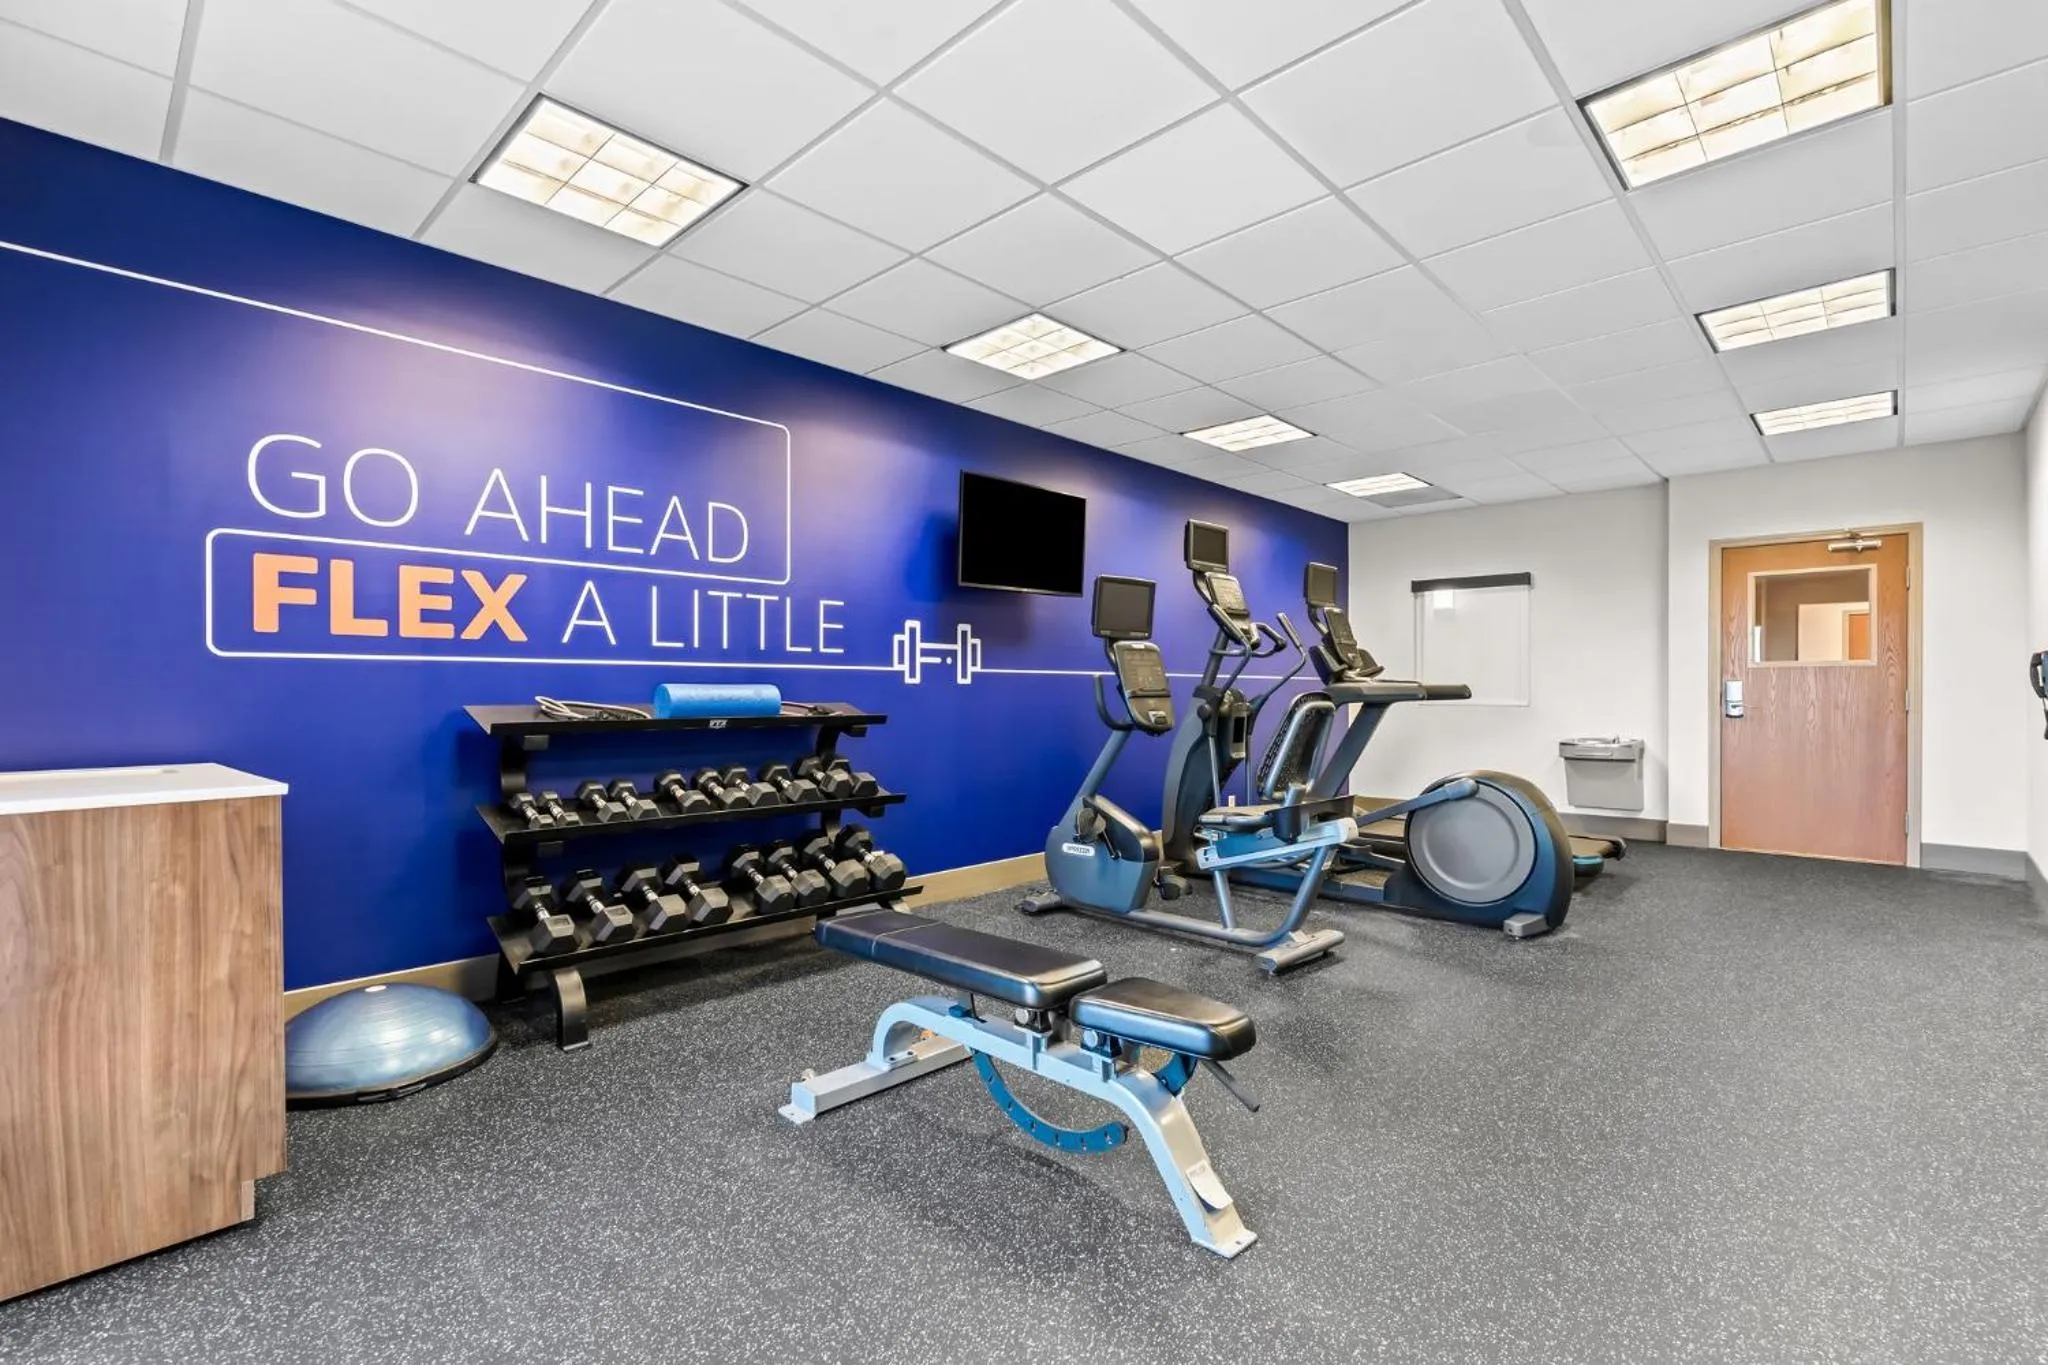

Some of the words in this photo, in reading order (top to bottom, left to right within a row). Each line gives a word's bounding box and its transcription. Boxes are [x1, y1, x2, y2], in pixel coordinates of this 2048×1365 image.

[247, 433, 419, 529] GO
[465, 467, 749, 564] AHEAD
[253, 552, 528, 642] FLEX
[561, 579, 617, 646] A
[652, 586, 844, 653] LITTLE
